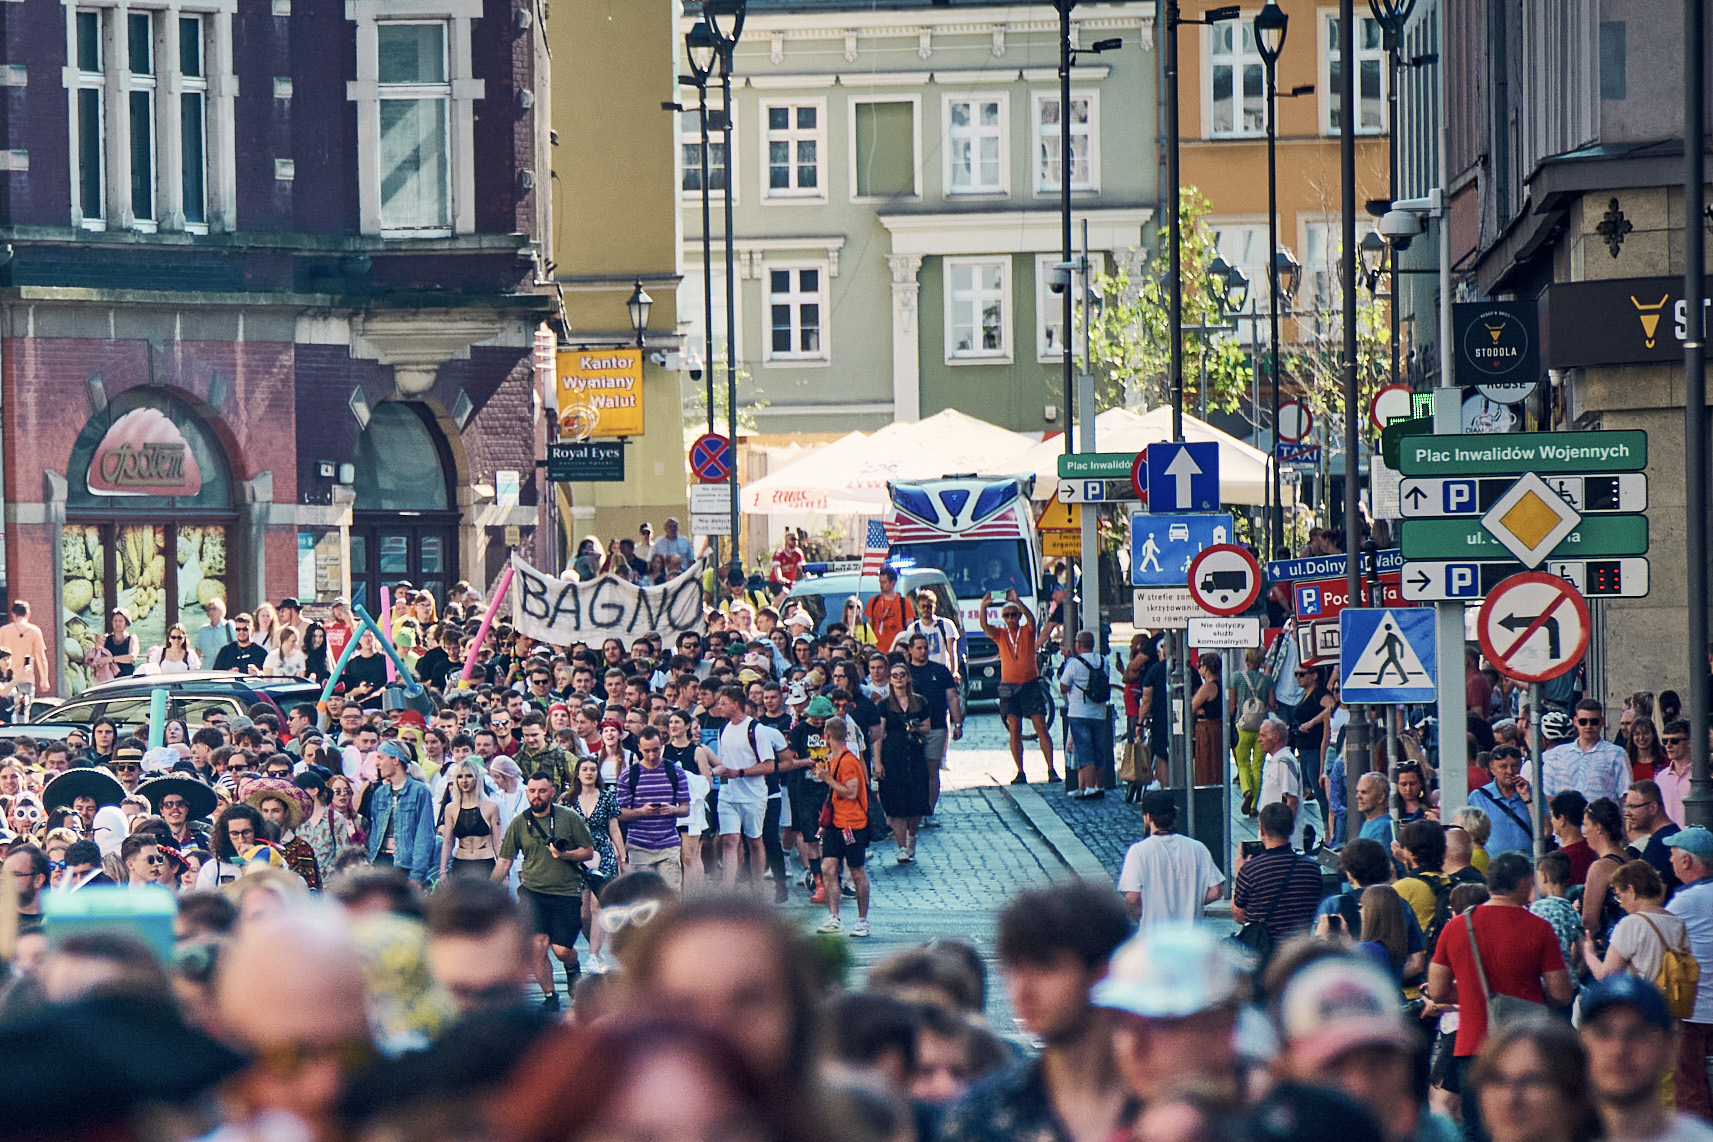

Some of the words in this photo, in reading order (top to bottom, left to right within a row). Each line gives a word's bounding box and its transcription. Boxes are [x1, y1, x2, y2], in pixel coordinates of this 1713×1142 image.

[580, 356, 635, 370] Kantor
[562, 375, 635, 391] Wymiany
[590, 394, 636, 409] Walut
[552, 447, 588, 460] Royal
[591, 447, 620, 460] Eyes
[1280, 446, 1318, 460] TAXI
[1415, 448, 1451, 462] Plac
[1454, 446, 1535, 461] Inwalidów
[1538, 444, 1630, 463] Wojennych
[1067, 461, 1088, 470] Plac
[1090, 460, 1133, 470] Inwalidó
[1087, 482, 1100, 500] P
[1449, 484, 1469, 511] P
[1466, 532, 1486, 545] ul.
[1451, 567, 1472, 595] P
[522, 569, 705, 633] BAGNO
[1146, 604, 1200, 613] skrzyżowania
[1212, 629, 1233, 637] służb
[1215, 622, 1245, 630] dotyczy
[1197, 638, 1249, 646] komunalnych
